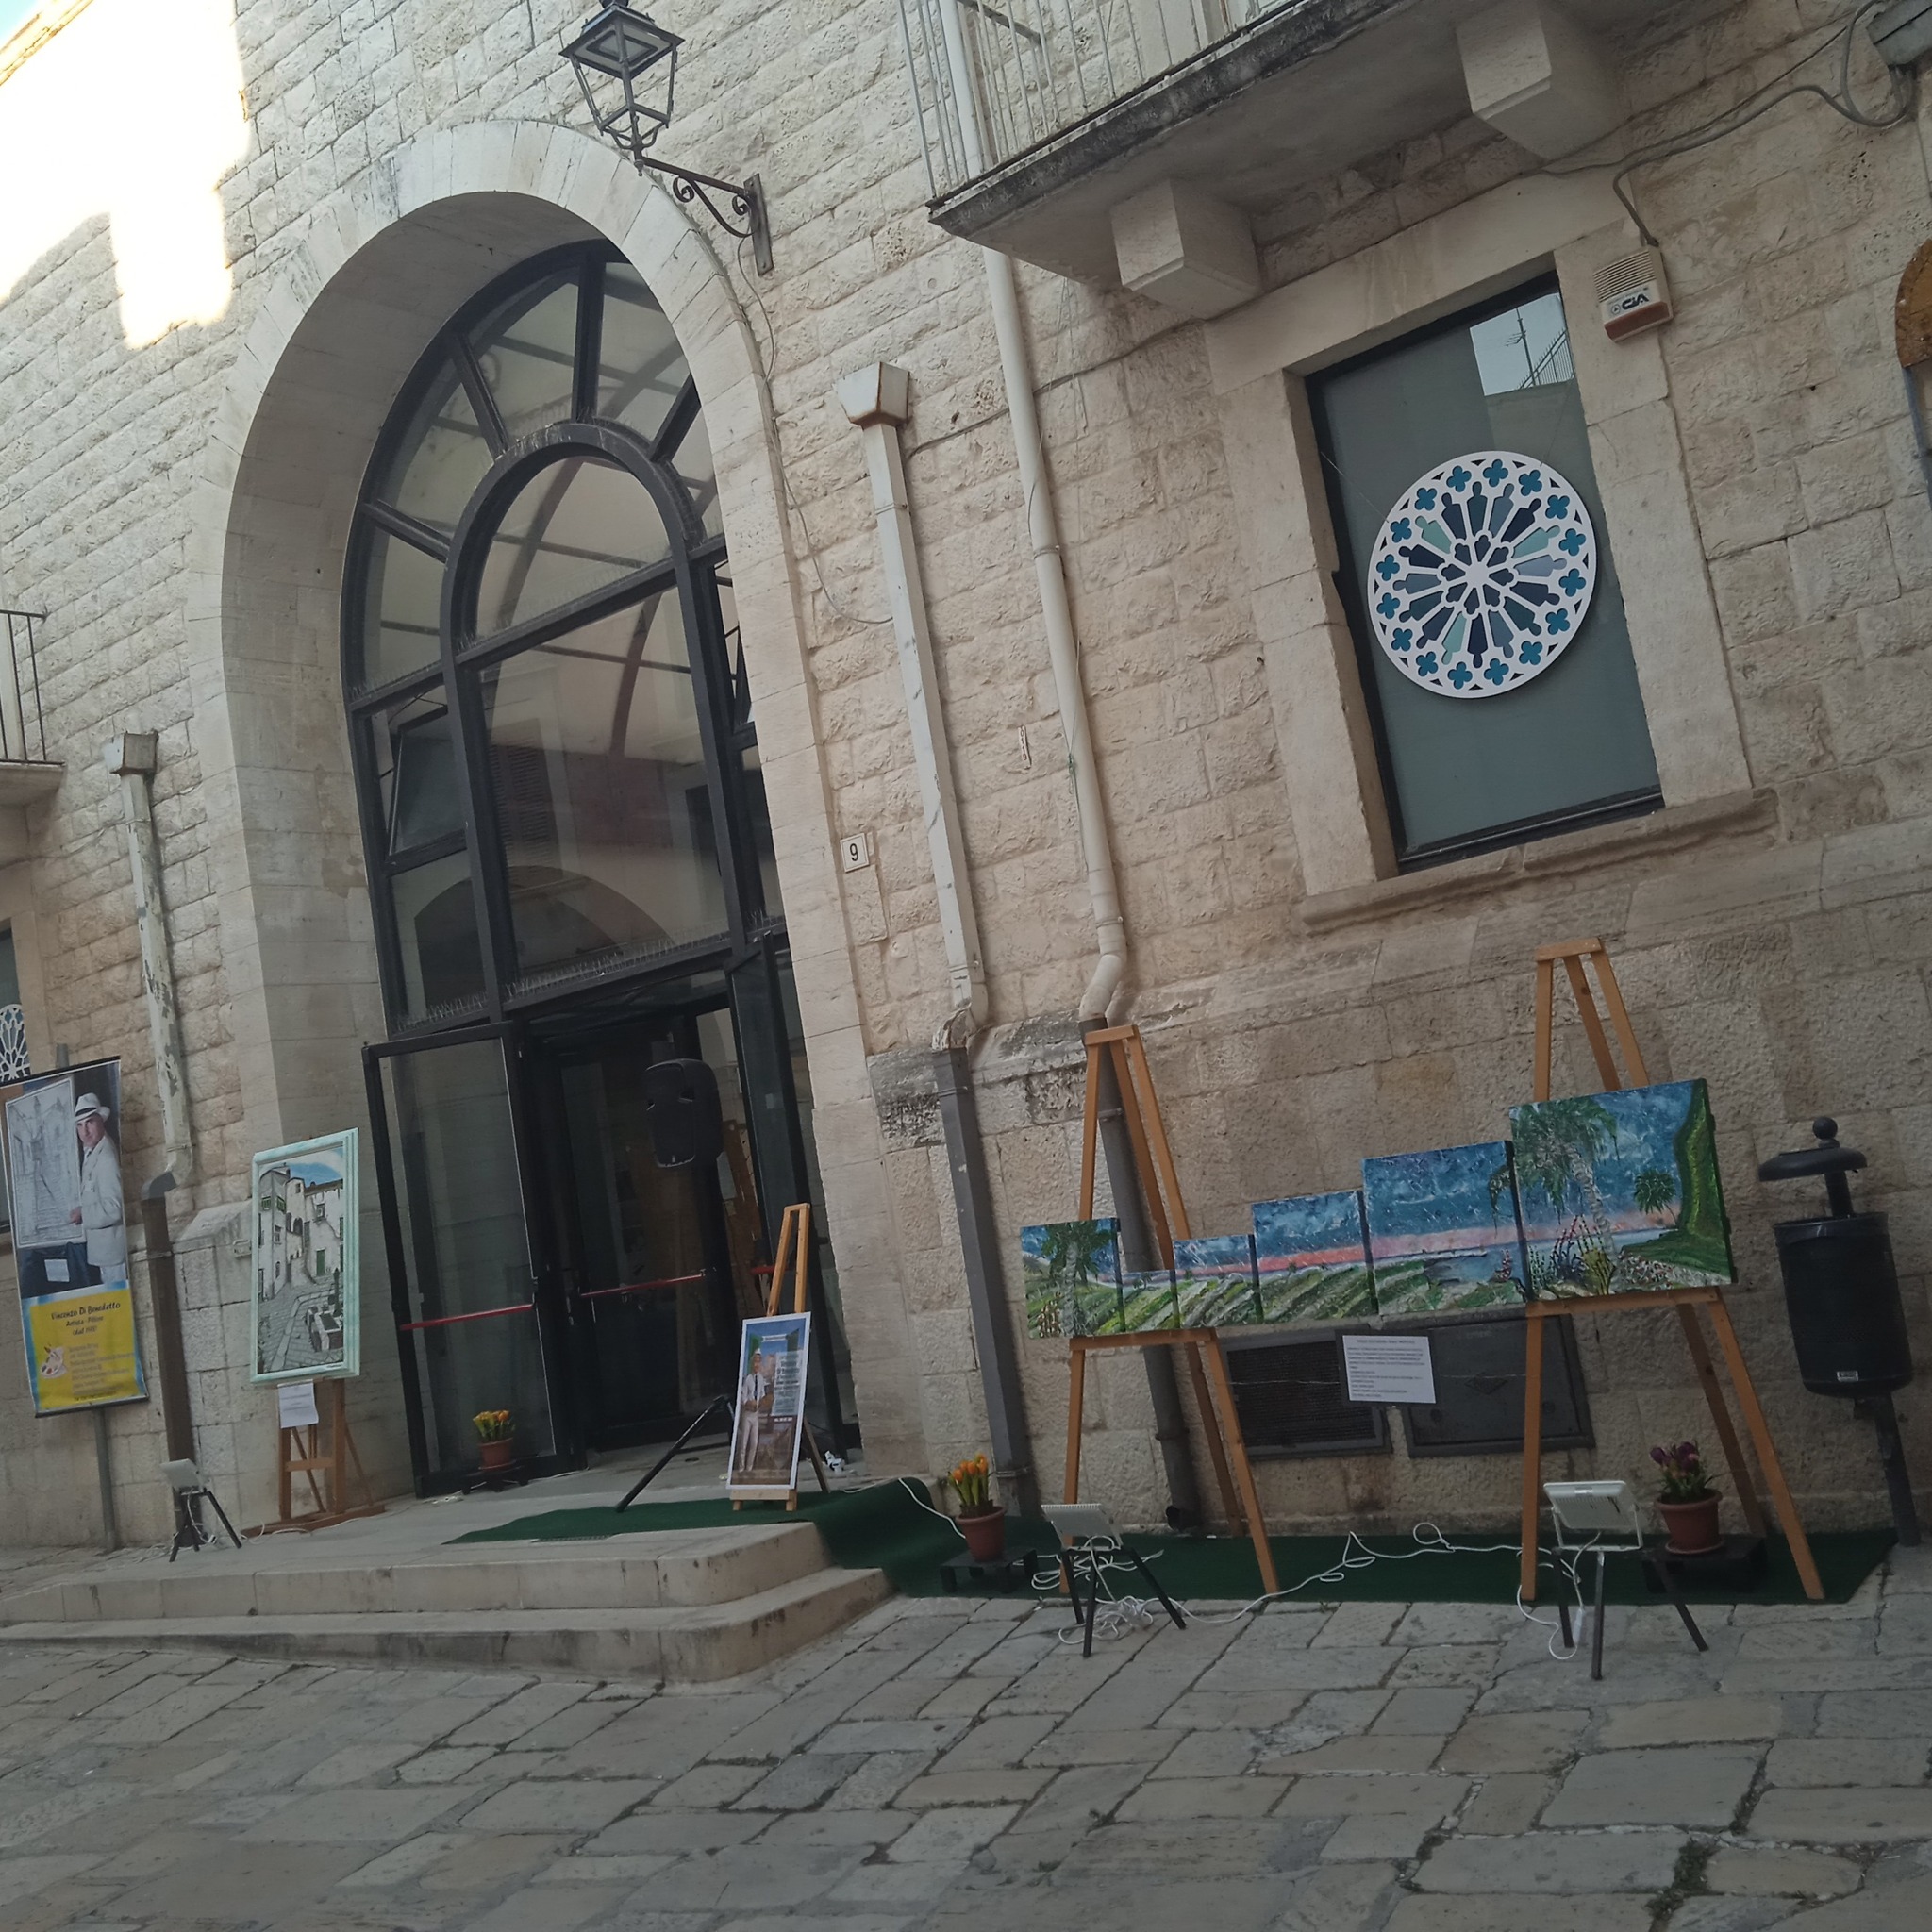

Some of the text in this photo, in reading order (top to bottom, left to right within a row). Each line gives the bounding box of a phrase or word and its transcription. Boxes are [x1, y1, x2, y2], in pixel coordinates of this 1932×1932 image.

[849, 842, 858, 861] 9
[79, 1307, 86, 1315] Di
[88, 1302, 120, 1314] Benedetto
